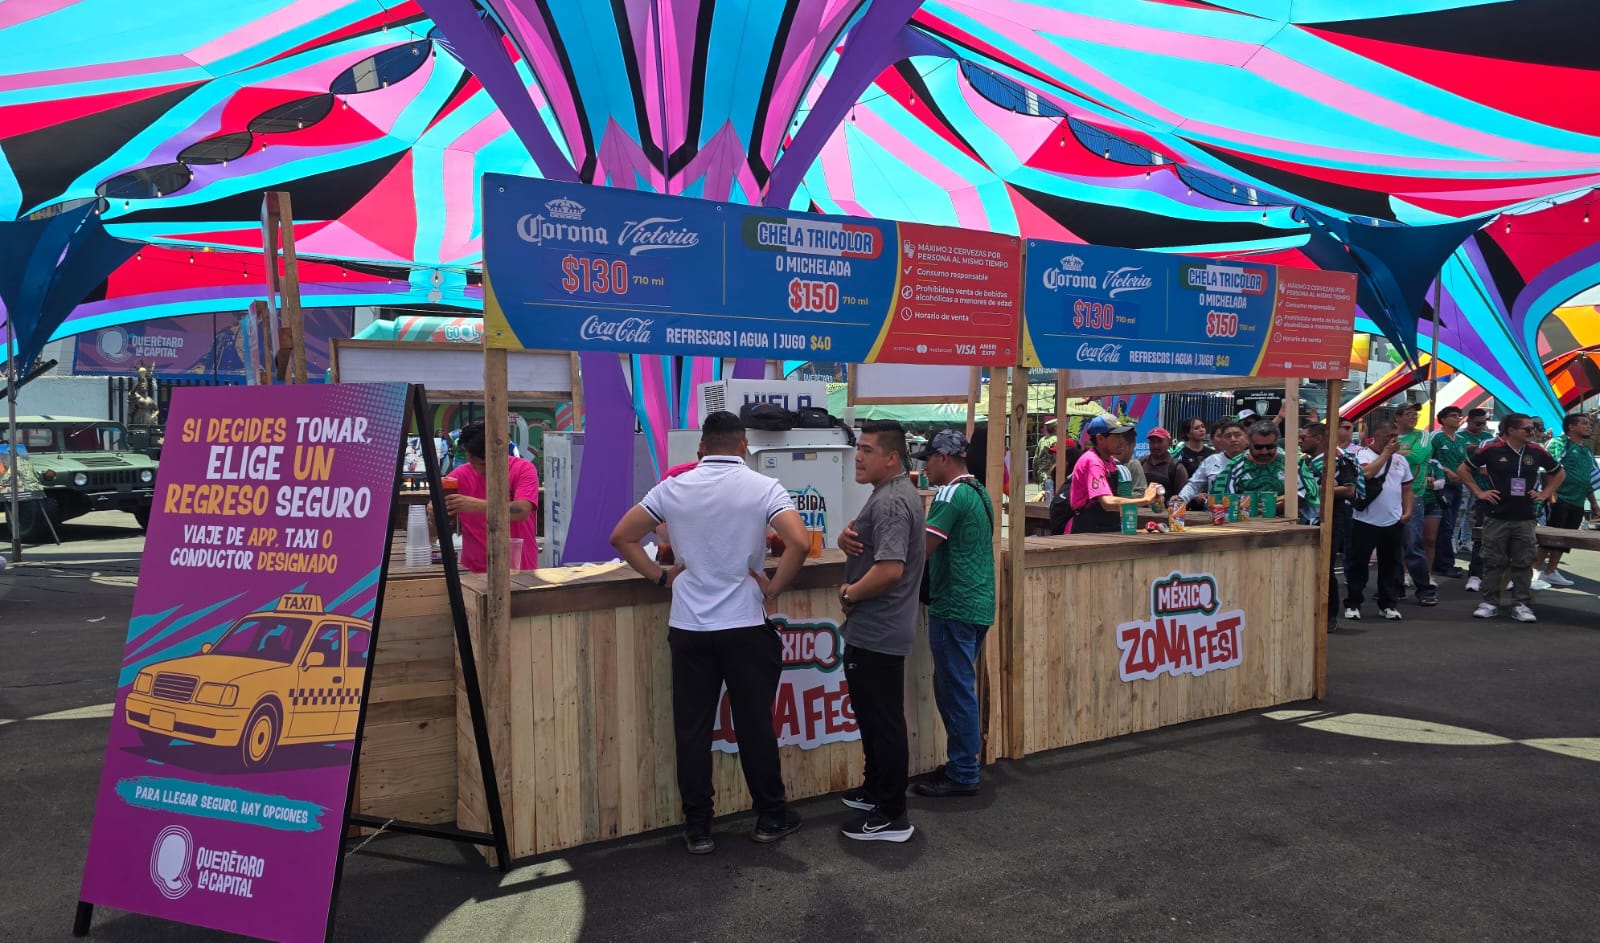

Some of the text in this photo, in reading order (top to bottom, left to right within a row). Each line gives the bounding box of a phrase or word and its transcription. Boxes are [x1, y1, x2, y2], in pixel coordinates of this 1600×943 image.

[516, 213, 699, 256] Corona Victoria
[758, 222, 873, 254] CHELA TRICOLOR
[775, 255, 851, 277] O MICHELADA
[917, 253, 951, 263] PERSONA
[962, 257, 984, 266] MISMO
[985, 260, 1009, 268] TIEMPO
[953, 247, 987, 257] CERVEZAS
[987, 251, 1001, 259] POR
[562, 254, 664, 294] $130 710 ml
[916, 268, 989, 281] Consumo responsable
[1042, 266, 1152, 298] Corona Victoria
[1188, 268, 1262, 292] CHELA TRICOLOR
[788, 278, 839, 313] $150
[1199, 293, 1247, 309] O MICHELADA
[914, 311, 940, 320] Horario
[1073, 299, 1114, 330] $130
[1206, 310, 1239, 338] $150
[144, 346, 178, 358] CAPITAL
[666, 327, 730, 346] REFRESCOS
[740, 332, 768, 348] AGUA
[779, 334, 805, 350] JUGO
[810, 335, 831, 351] $40
[955, 344, 977, 355] VISA
[1129, 350, 1170, 364] REFRESCOS
[1175, 353, 1193, 365] AGUA
[1198, 354, 1214, 366] JUGO
[182, 416, 372, 444] SI DECIDES TOMAR,
[206, 445, 335, 481] ELIGE UN
[164, 484, 371, 518] REGRESO SEGURO
[790, 495, 826, 512] BIDA
[183, 524, 223, 545] VIAJE
[226, 527, 246, 546] DE
[285, 528, 318, 549] TAXI
[322, 529, 333, 549] O
[170, 547, 338, 574] CONDUCTOR DESIGNADO
[284, 596, 313, 610] TAXI
[1122, 616, 1241, 675] ZONA FEST
[803, 680, 860, 741] FES
[135, 785, 160, 801] PARA
[163, 789, 199, 807] LLEGAR
[241, 801, 261, 817] HAY
[262, 804, 309, 824] OPCIONES
[196, 846, 265, 878] QUERÉTARO
[197, 870, 253, 898] LA CAPITAL
